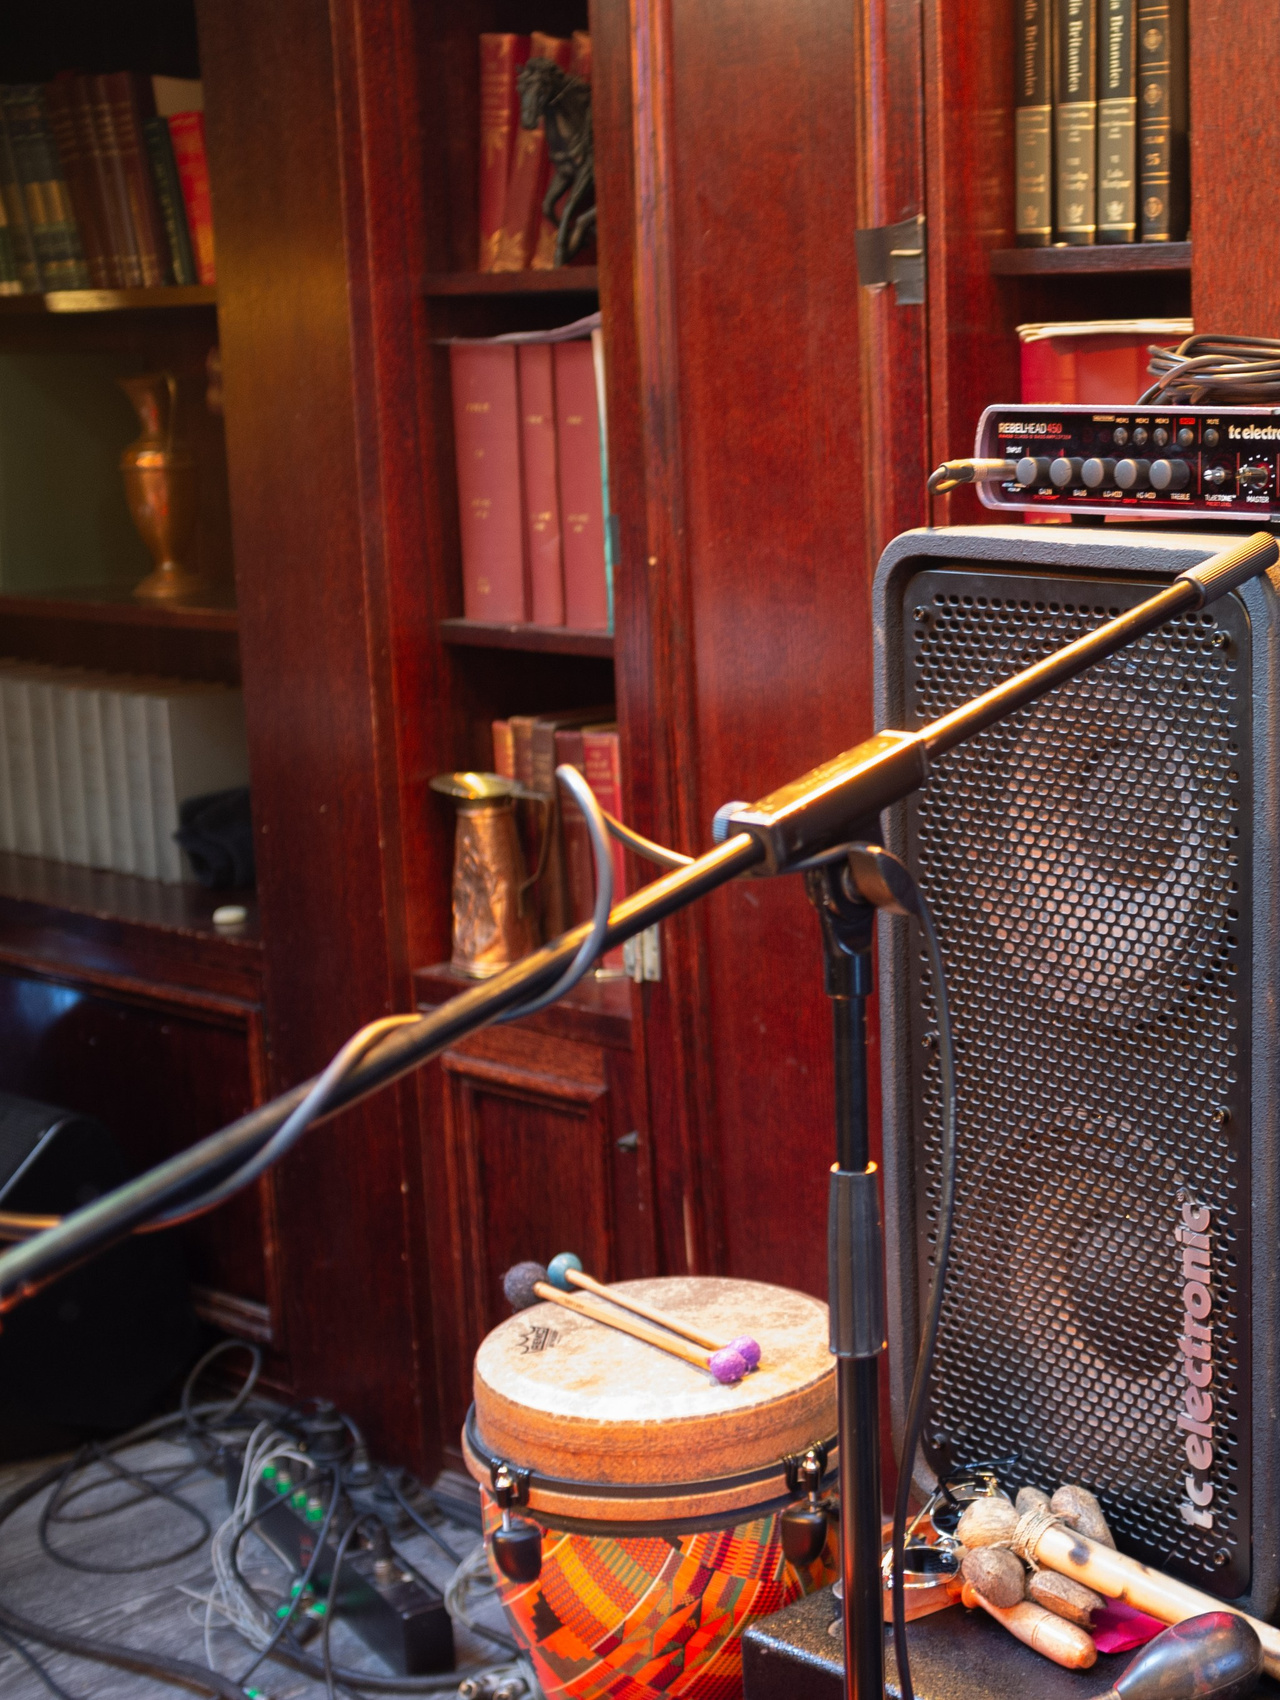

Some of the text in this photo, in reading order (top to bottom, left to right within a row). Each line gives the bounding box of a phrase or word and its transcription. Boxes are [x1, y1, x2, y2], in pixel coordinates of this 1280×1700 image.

[1228, 425, 1242, 439] tc
[1174, 1202, 1214, 1529] tc electronic
